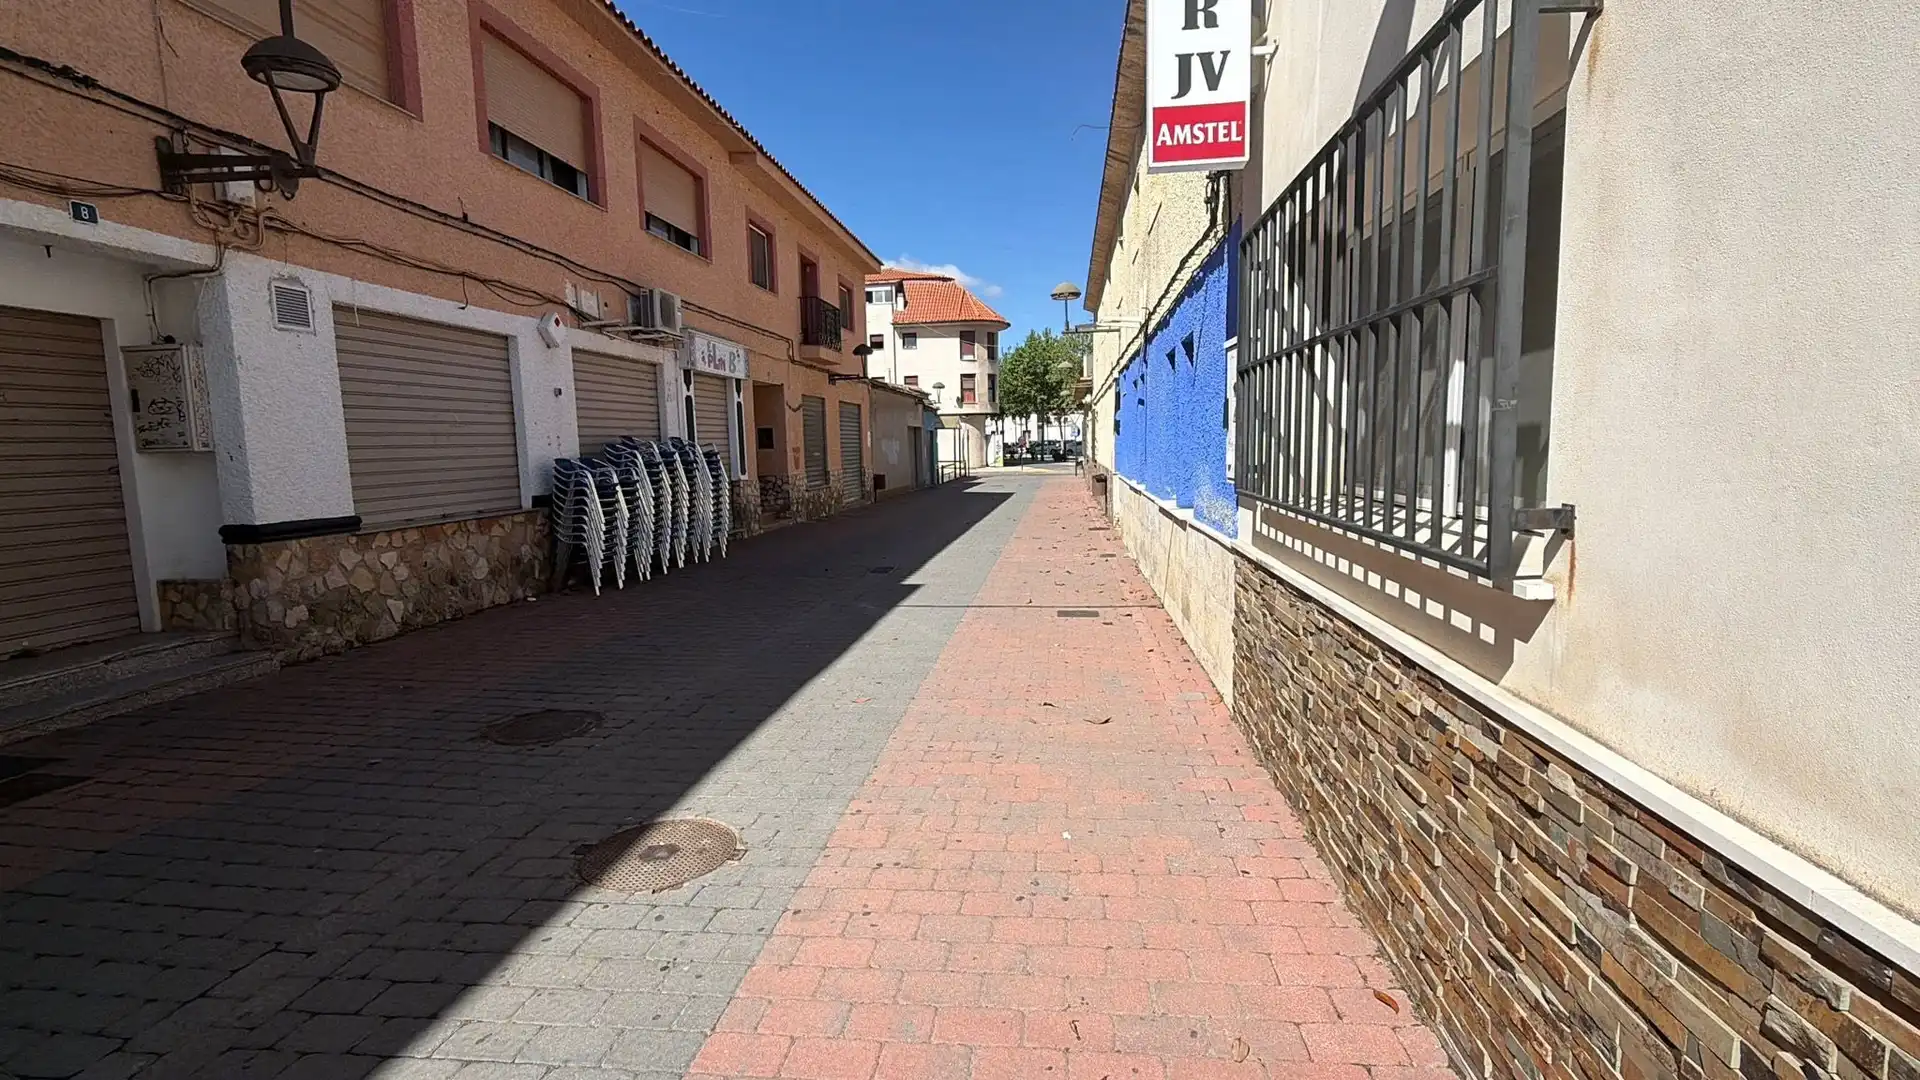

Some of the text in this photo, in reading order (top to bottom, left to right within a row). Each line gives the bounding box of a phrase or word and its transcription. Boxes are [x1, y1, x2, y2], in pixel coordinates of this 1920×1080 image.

[1170, 50, 1231, 99] JV
[1156, 120, 1242, 146] AMSTEL
[80, 206, 90, 220] 8
